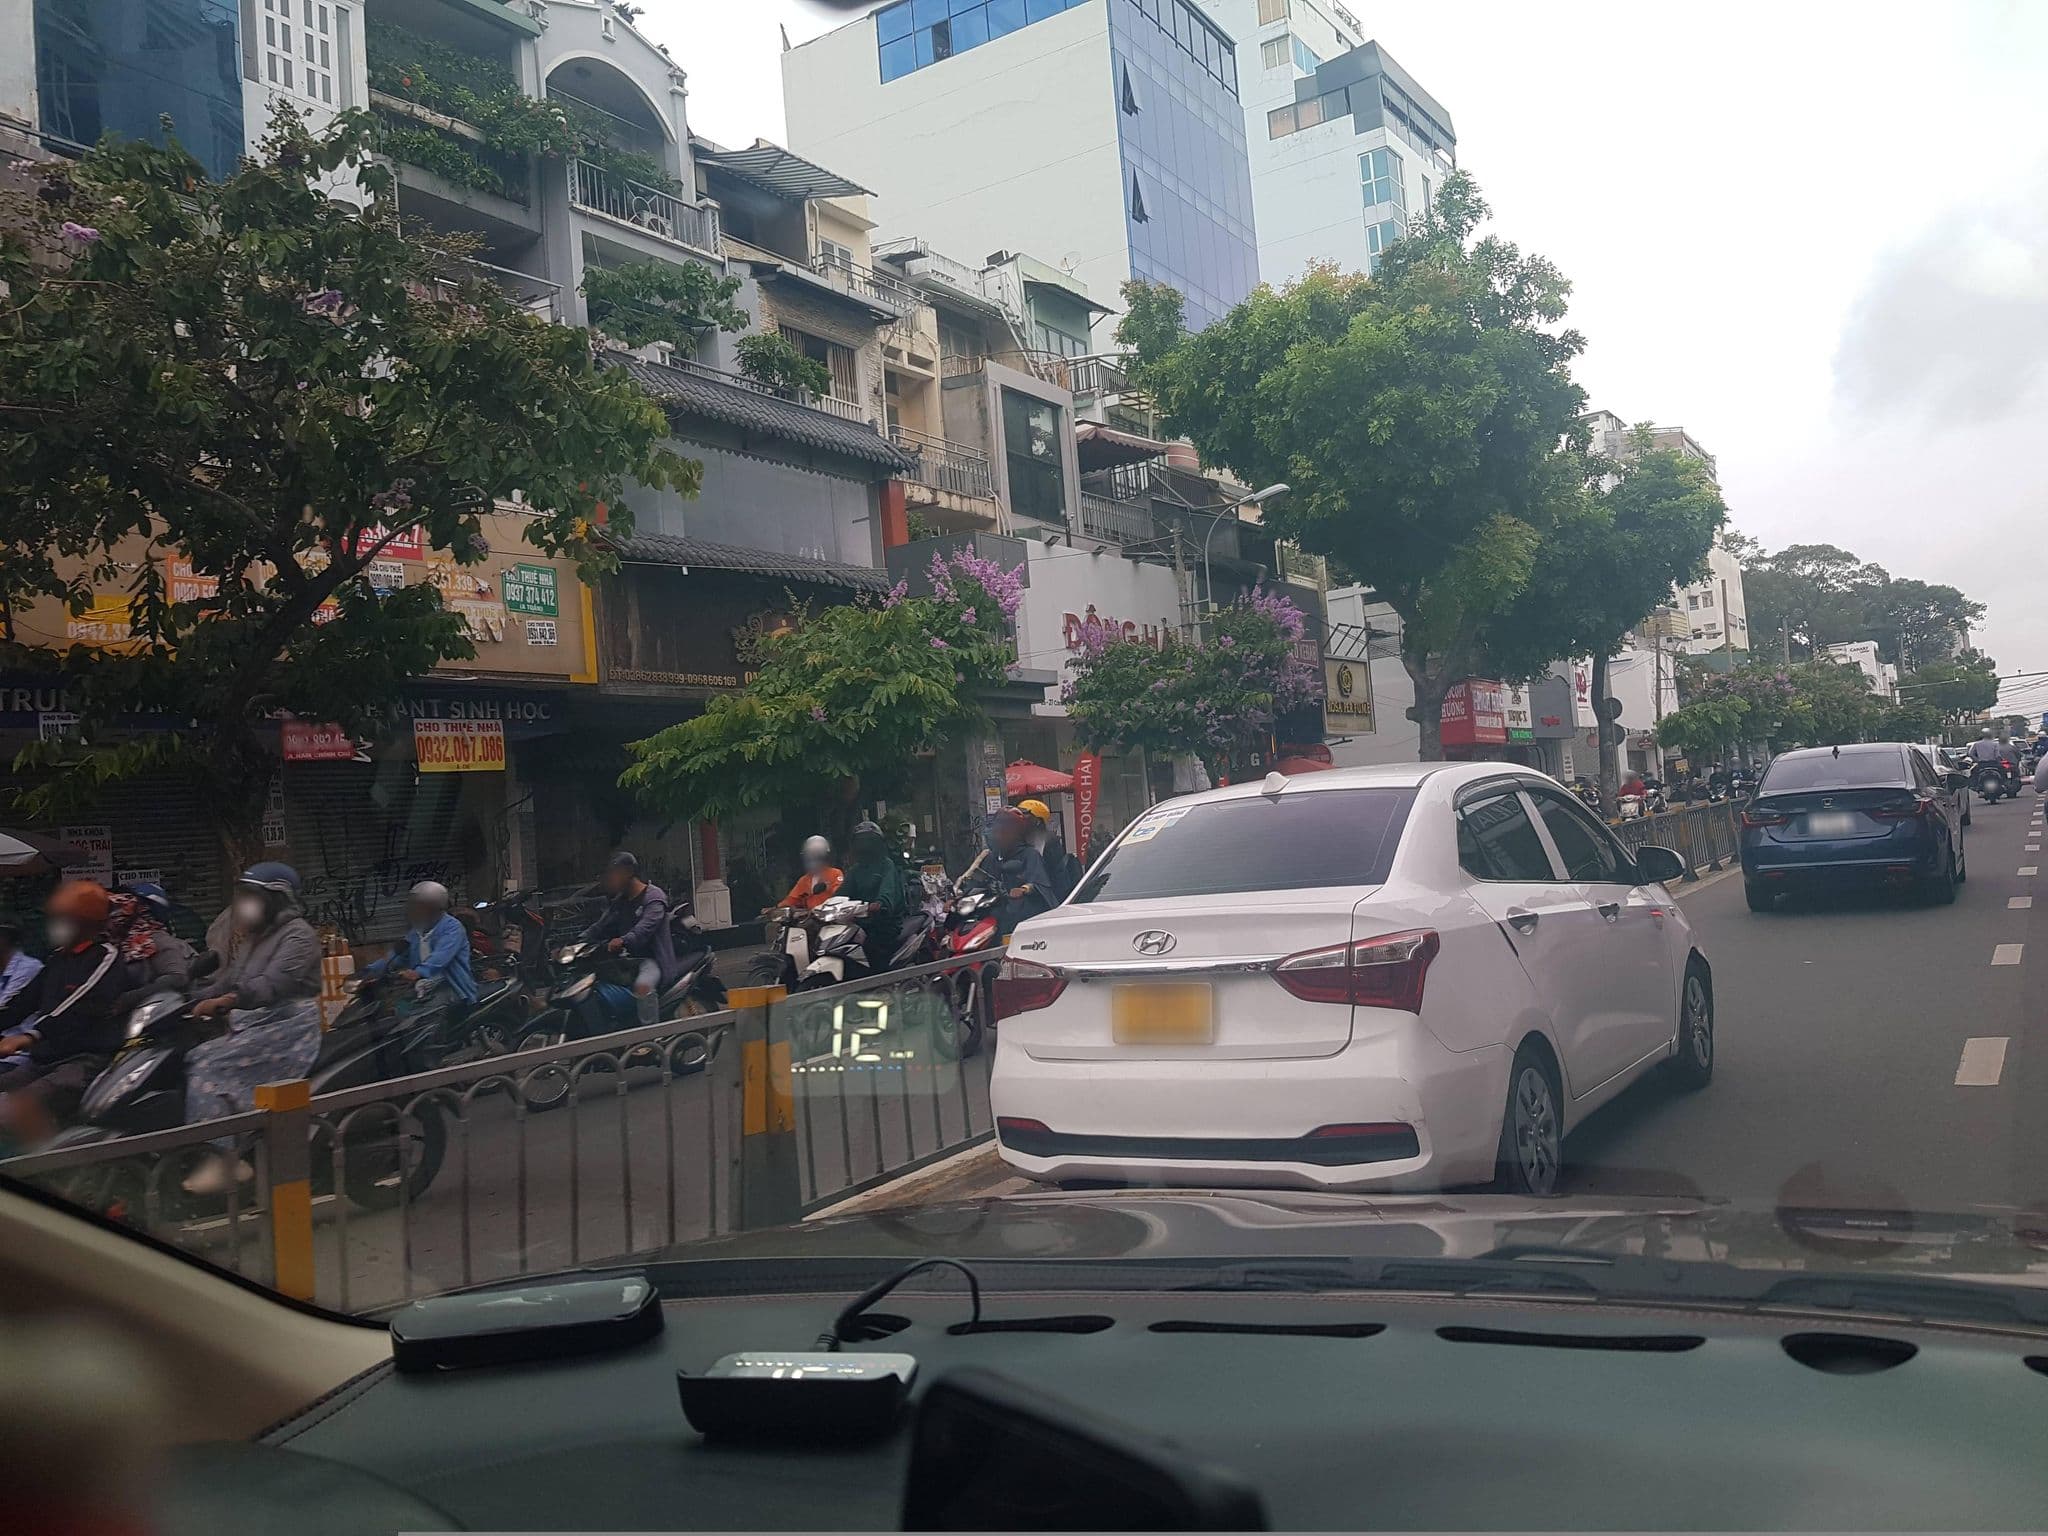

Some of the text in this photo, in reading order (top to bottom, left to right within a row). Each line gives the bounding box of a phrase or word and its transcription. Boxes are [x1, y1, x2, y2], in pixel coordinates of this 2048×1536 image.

[541, 589, 555, 606] 412
[450, 700, 500, 720] SINH
[508, 700, 551, 724] HỌC
[415, 719, 502, 733] CHO THUÊ NHÀ
[832, 1000, 888, 1062] 12
